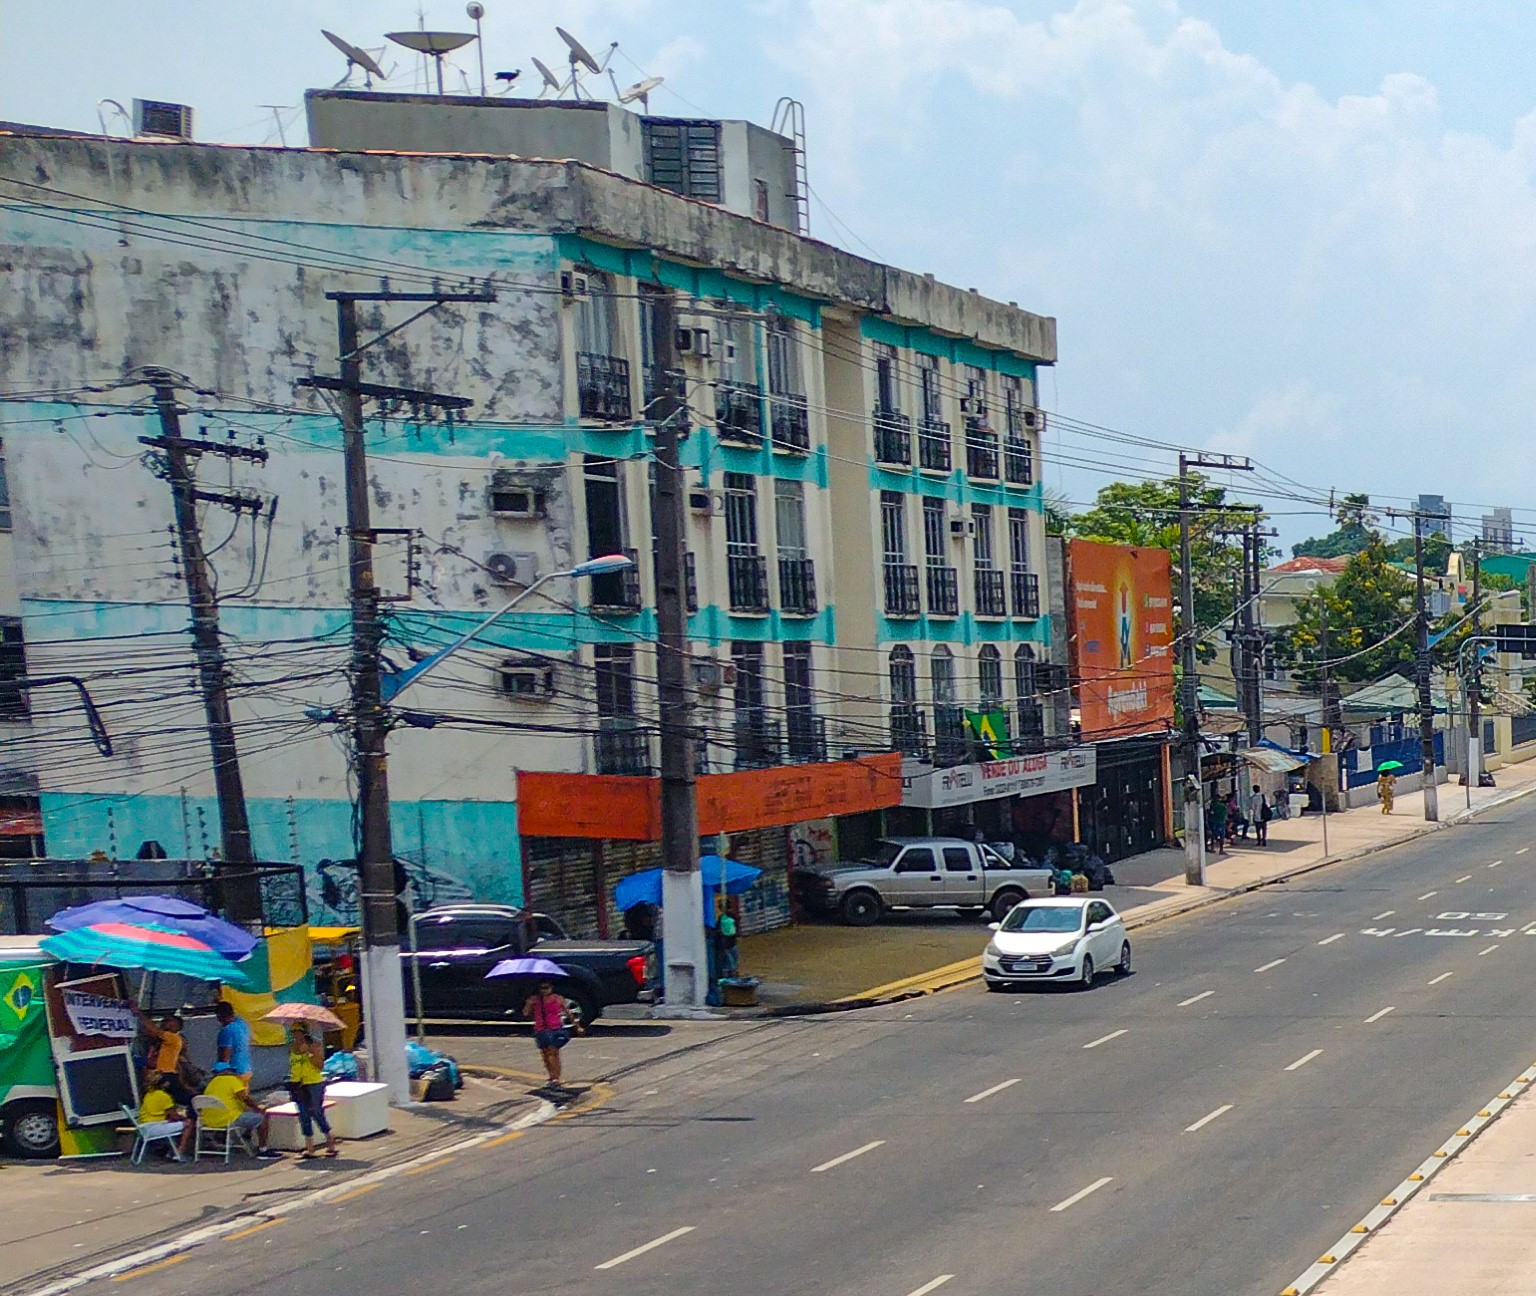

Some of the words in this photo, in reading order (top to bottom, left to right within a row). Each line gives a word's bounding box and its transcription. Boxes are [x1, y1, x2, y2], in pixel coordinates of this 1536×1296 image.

[981, 761, 1006, 779] VENDE
[1023, 754, 1047, 772] ALUGA
[1435, 911, 1508, 920] 50
[77, 1015, 133, 1032] FEDERAL
